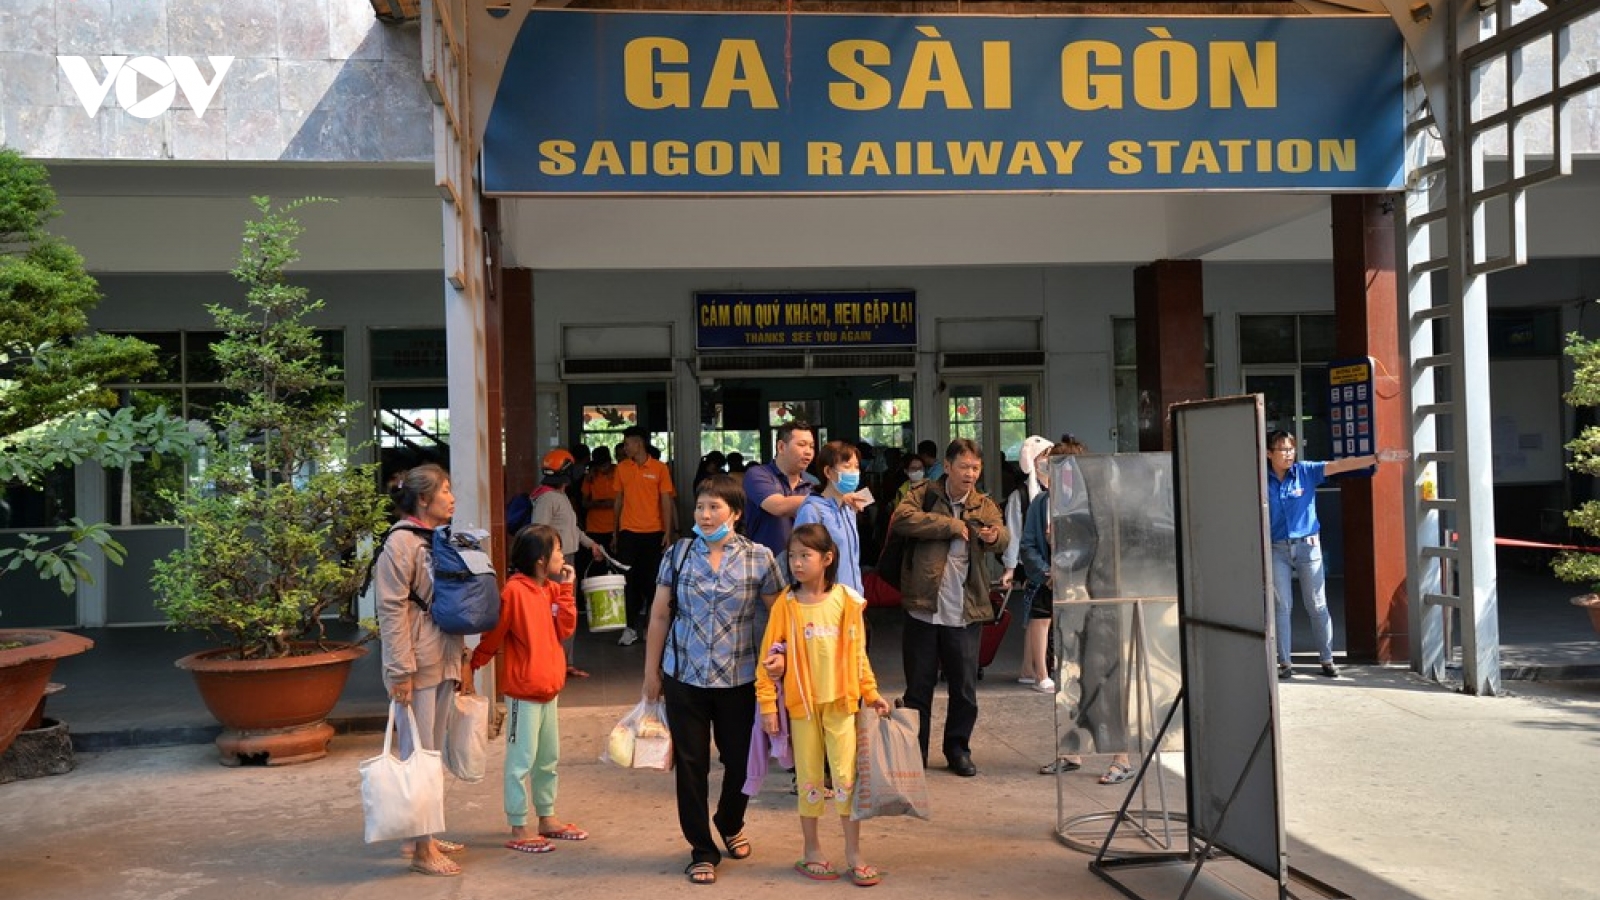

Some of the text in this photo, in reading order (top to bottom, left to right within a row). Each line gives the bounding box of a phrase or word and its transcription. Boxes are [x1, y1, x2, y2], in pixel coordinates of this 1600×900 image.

[624, 26, 1279, 111] GA SÀI GÒN
[538, 139, 1356, 176] SAIGON RAILWAY STATION
[755, 298, 780, 329] QUÝ
[785, 298, 831, 328] KHÁCH,
[834, 303, 861, 330] HẸN
[864, 298, 889, 329] GẶP
[892, 302, 913, 329] LẠI
[745, 331, 872, 343] THANKS SEE YOU AGAIN
